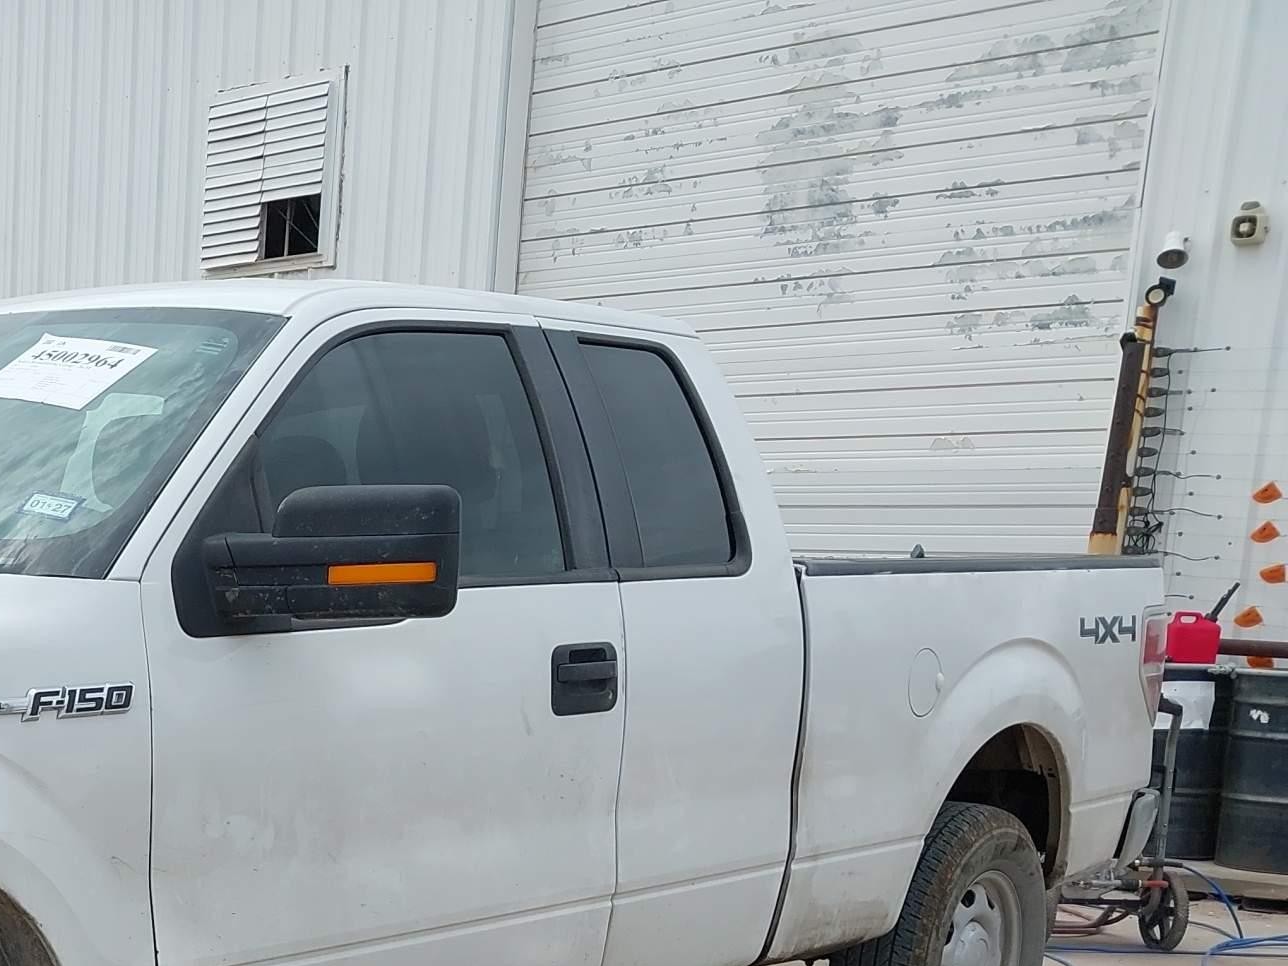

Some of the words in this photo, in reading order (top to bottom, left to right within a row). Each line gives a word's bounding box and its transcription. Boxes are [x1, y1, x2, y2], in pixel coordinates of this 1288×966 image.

[31, 350, 124, 369] 45002964
[1079, 614, 1136, 645] 4X4
[23, 682, 135, 720] F-150
